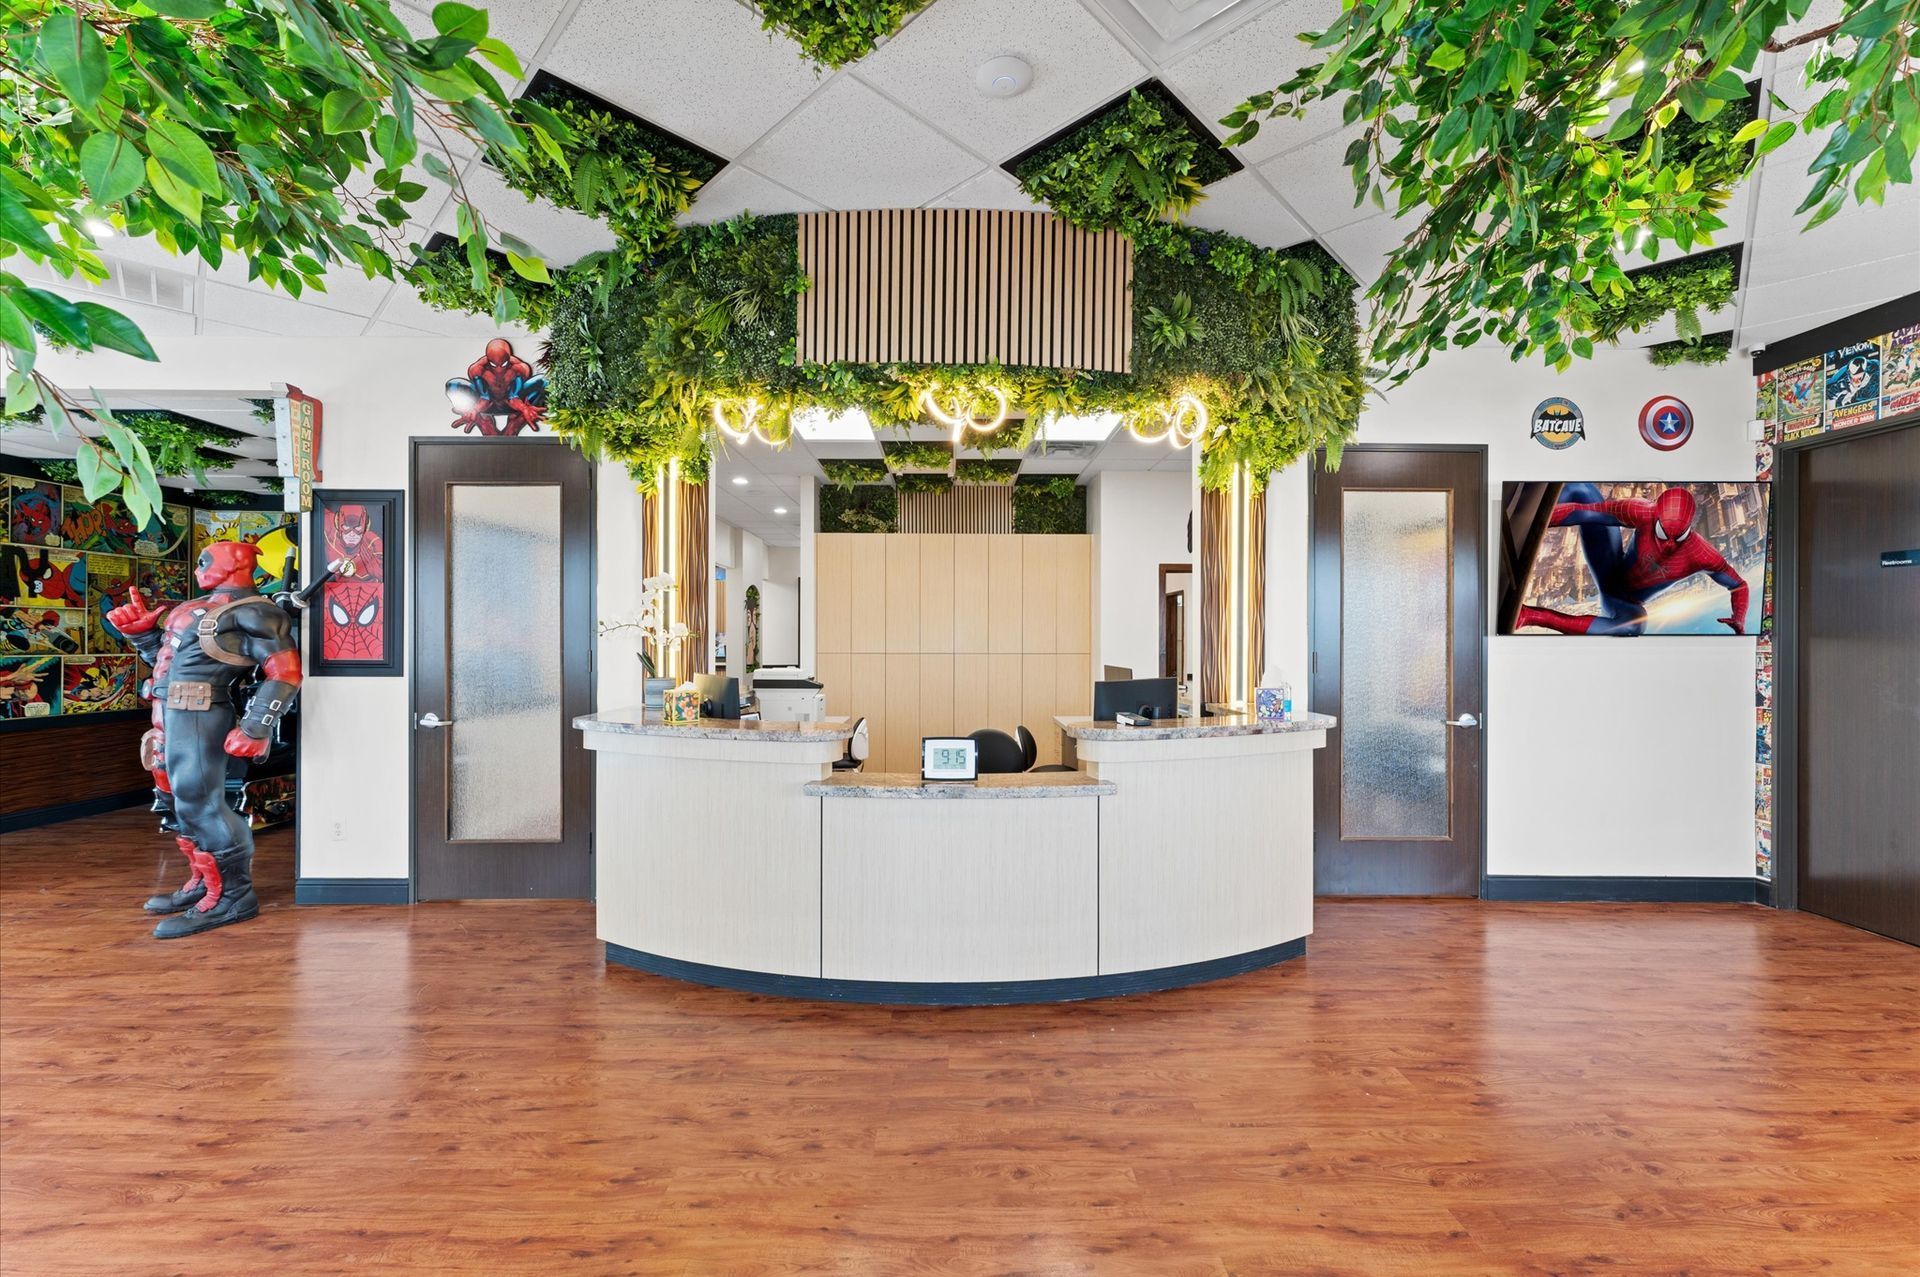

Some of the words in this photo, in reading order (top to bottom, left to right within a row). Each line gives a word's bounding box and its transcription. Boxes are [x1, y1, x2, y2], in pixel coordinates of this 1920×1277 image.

[1837, 341, 1874, 358] VENOM
[1833, 402, 1874, 418] AVENGERS
[301, 403, 312, 453] GAME
[1533, 418, 1582, 433] BATCAVE
[301, 457, 312, 508] ROOM
